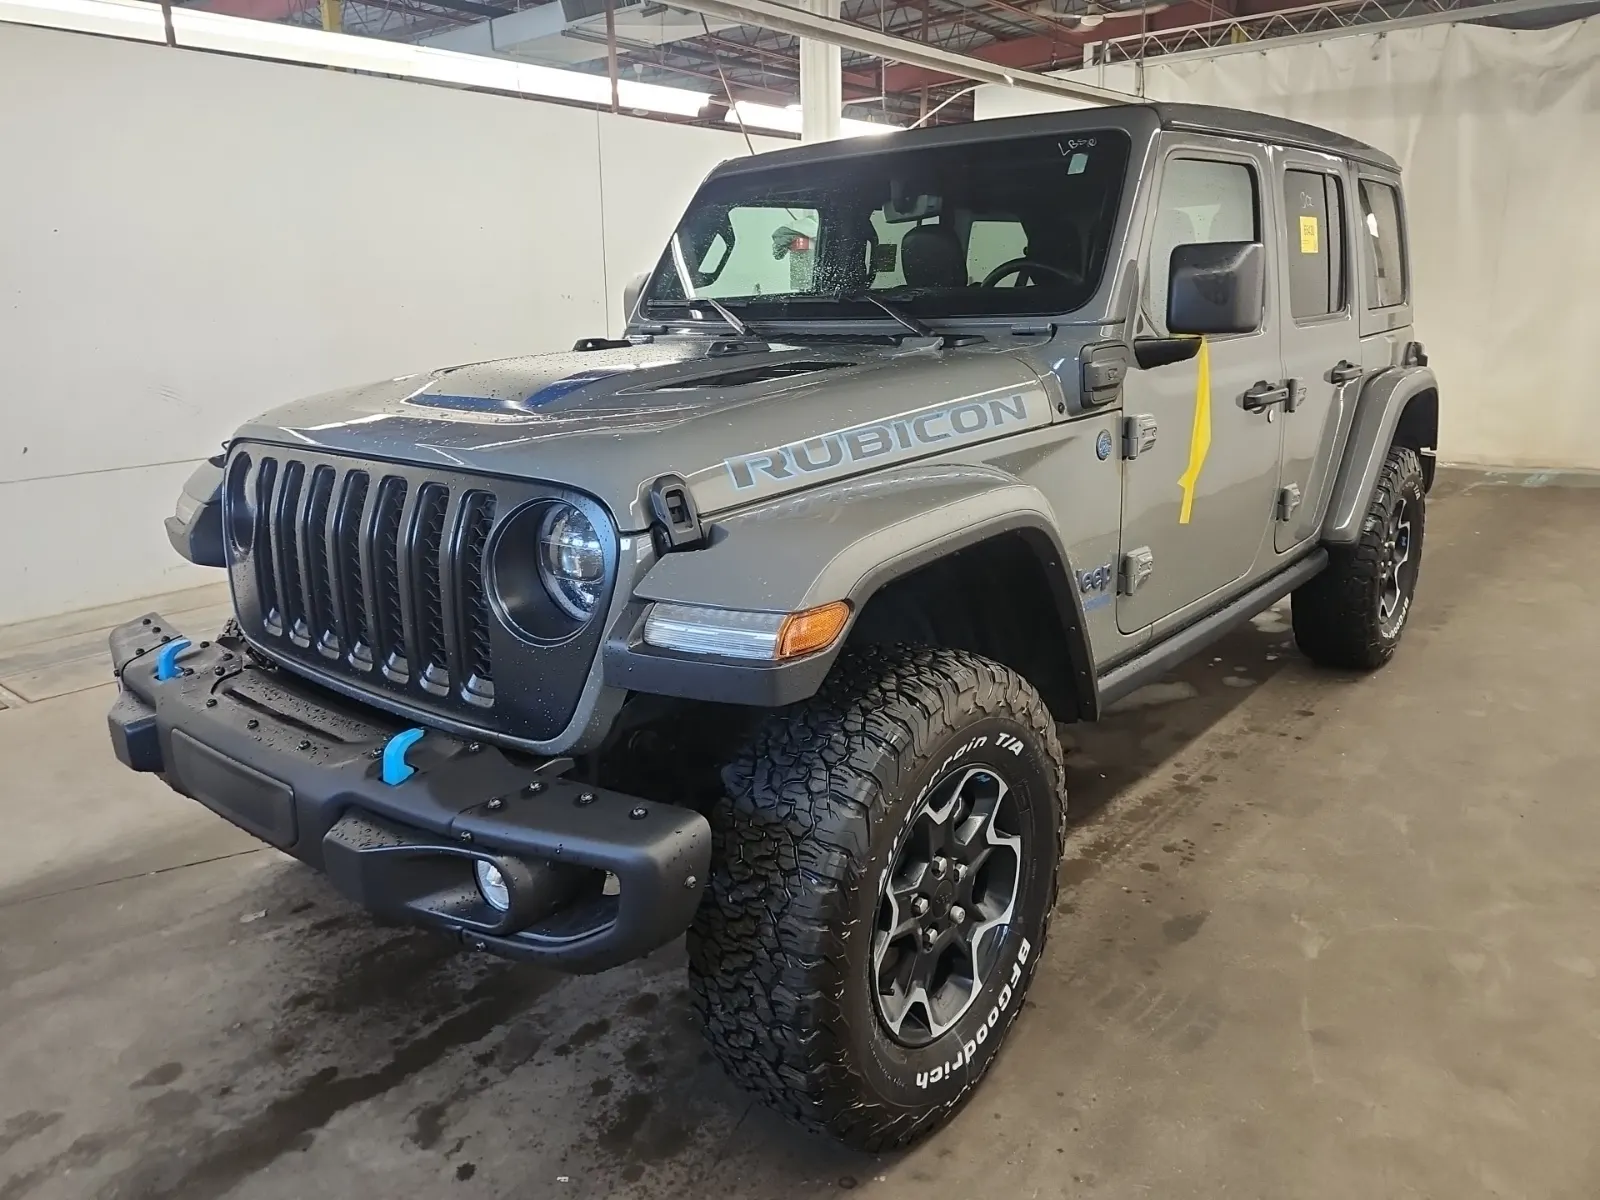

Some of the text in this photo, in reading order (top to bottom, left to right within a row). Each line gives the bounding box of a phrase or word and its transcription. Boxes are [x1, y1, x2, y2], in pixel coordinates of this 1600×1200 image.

[723, 393, 1029, 490] RUBICON
[1076, 563, 1112, 593] Jeep
[994, 731, 1025, 757] T/A
[915, 937, 1032, 1090] BFGoodrich
